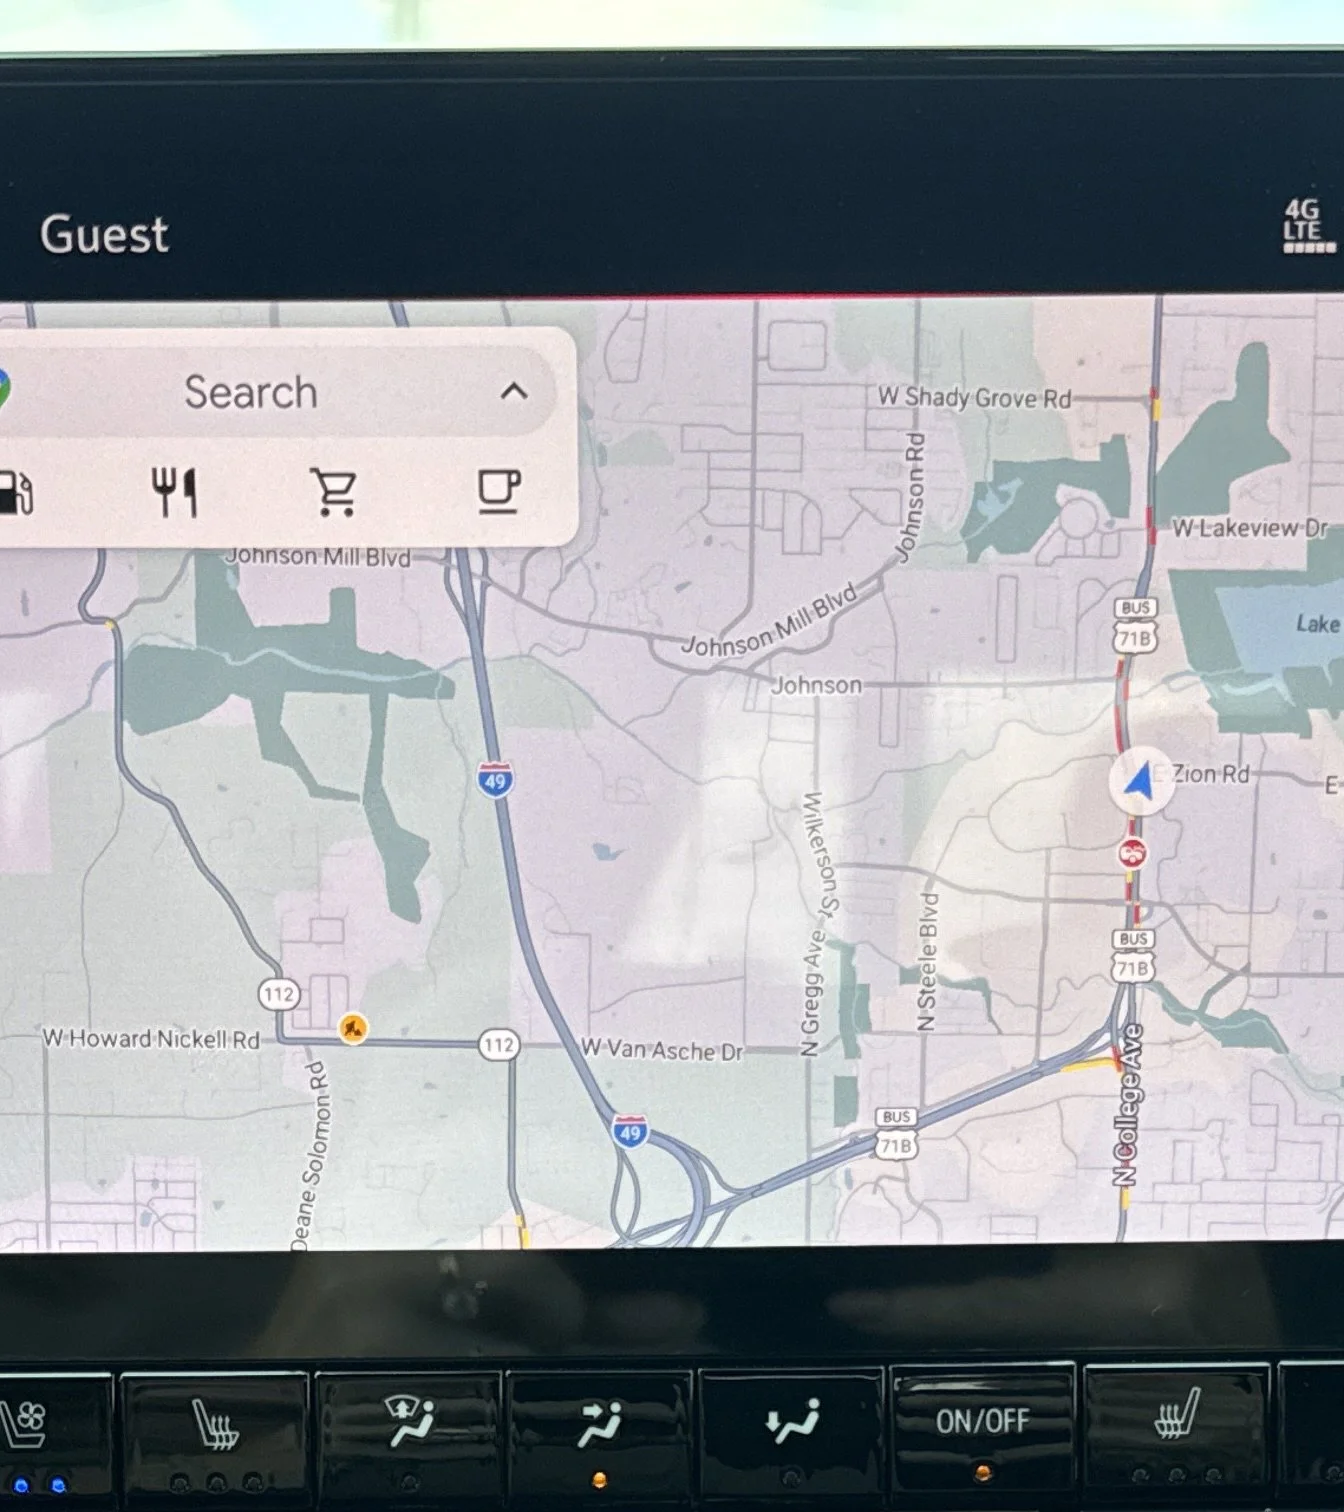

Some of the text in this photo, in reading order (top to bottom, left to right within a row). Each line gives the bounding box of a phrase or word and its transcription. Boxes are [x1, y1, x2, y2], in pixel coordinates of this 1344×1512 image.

[1285, 198, 1320, 220] 4G
[41, 213, 170, 256] Guest
[1284, 222, 1321, 240] LTE
[185, 373, 319, 411] Search
[878, 387, 1072, 412] W Shady Grove Rd
[895, 433, 924, 564] Johnson Rd
[1173, 517, 1329, 539] W Lakeview Dr
[225, 547, 411, 568] Johnson Mill Blvd
[1122, 600, 1150, 614] BUS
[681, 582, 858, 657] Johnson Mill Blvd
[1297, 611, 1342, 634] Lake
[1120, 630, 1151, 646] 71B
[771, 674, 863, 695] Johnson
[485, 772, 506, 789] 49
[1173, 763, 1217, 783] Zion
[1223, 765, 1249, 783] Rd
[1325, 776, 1338, 795] E
[803, 792, 840, 919] Wilkerson St
[1119, 932, 1148, 945] BUS
[918, 892, 939, 1032] N Steele Blvd
[1117, 960, 1149, 975] 71B
[264, 986, 294, 1001] 112
[801, 931, 827, 1058] N Gregg Ave
[42, 1027, 260, 1051] W Howard Nickell Rd
[484, 1037, 514, 1052] 112
[581, 1037, 743, 1062] W Van Asche Dr
[1114, 1023, 1145, 1186] N College Ave
[883, 1110, 911, 1123] BUS
[620, 1126, 641, 1141] 49
[290, 1061, 331, 1251] Deane Solomon Rd
[880, 1139, 912, 1153] 71B
[936, 1406, 1030, 1436] ON/OFF
